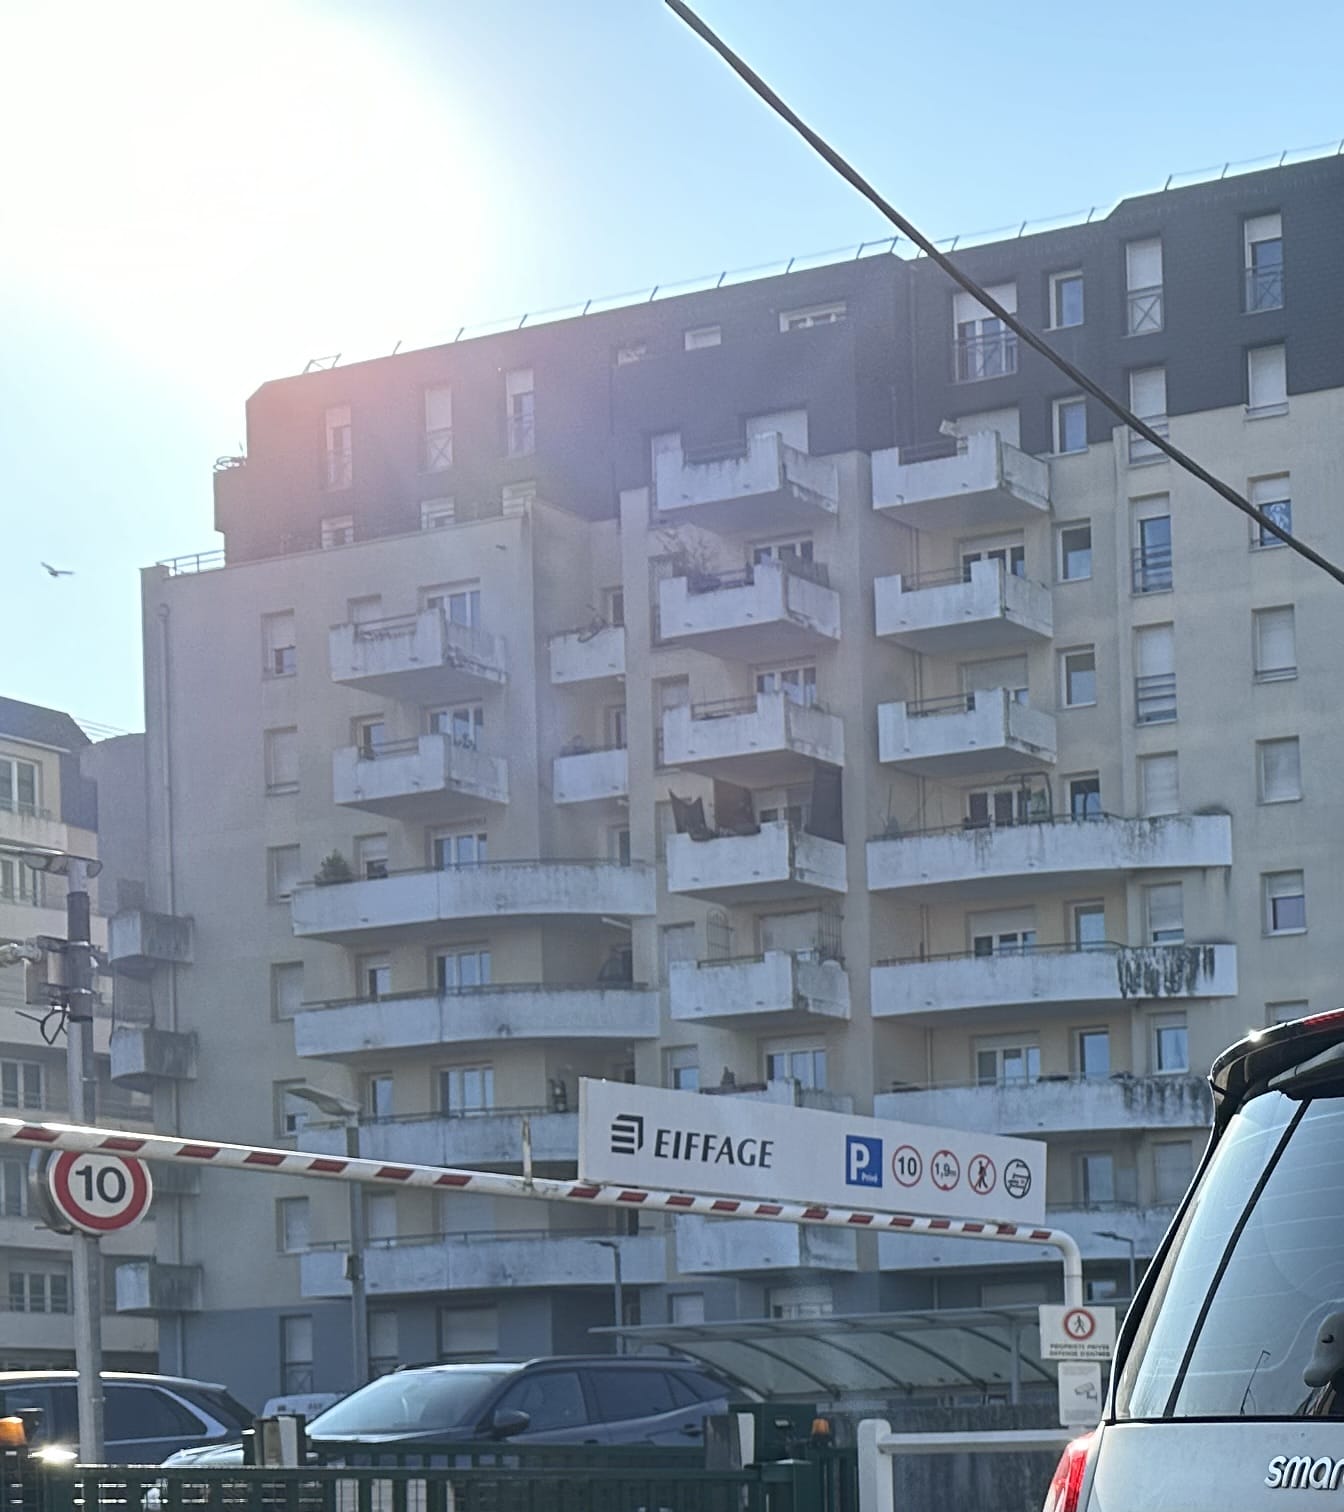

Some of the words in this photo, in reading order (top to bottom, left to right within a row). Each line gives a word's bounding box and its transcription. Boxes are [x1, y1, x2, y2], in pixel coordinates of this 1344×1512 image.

[654, 1129, 774, 1168] EIFFAGE
[850, 1142, 870, 1181] P
[898, 1156, 917, 1176] 10
[75, 1165, 126, 1203] 10
